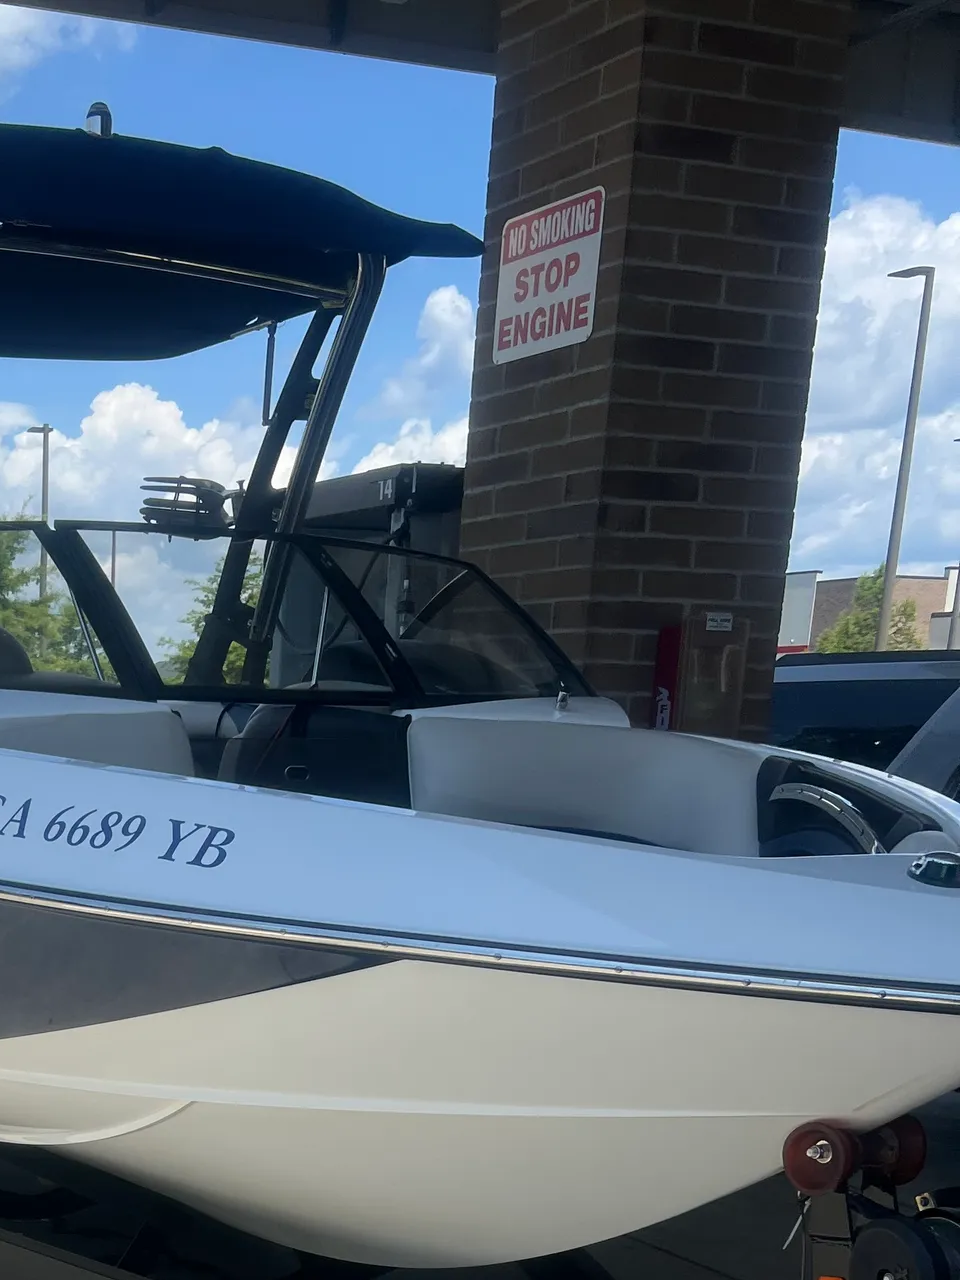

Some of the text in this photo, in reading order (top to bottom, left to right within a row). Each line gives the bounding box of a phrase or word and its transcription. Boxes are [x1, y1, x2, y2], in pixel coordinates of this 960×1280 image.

[508, 199, 596, 258] NO SMOKING
[514, 252, 581, 303] STOP
[498, 292, 592, 351] ENGINE
[378, 479, 392, 500] 14
[43, 805, 146, 852] 6689
[158, 818, 236, 868] YB
